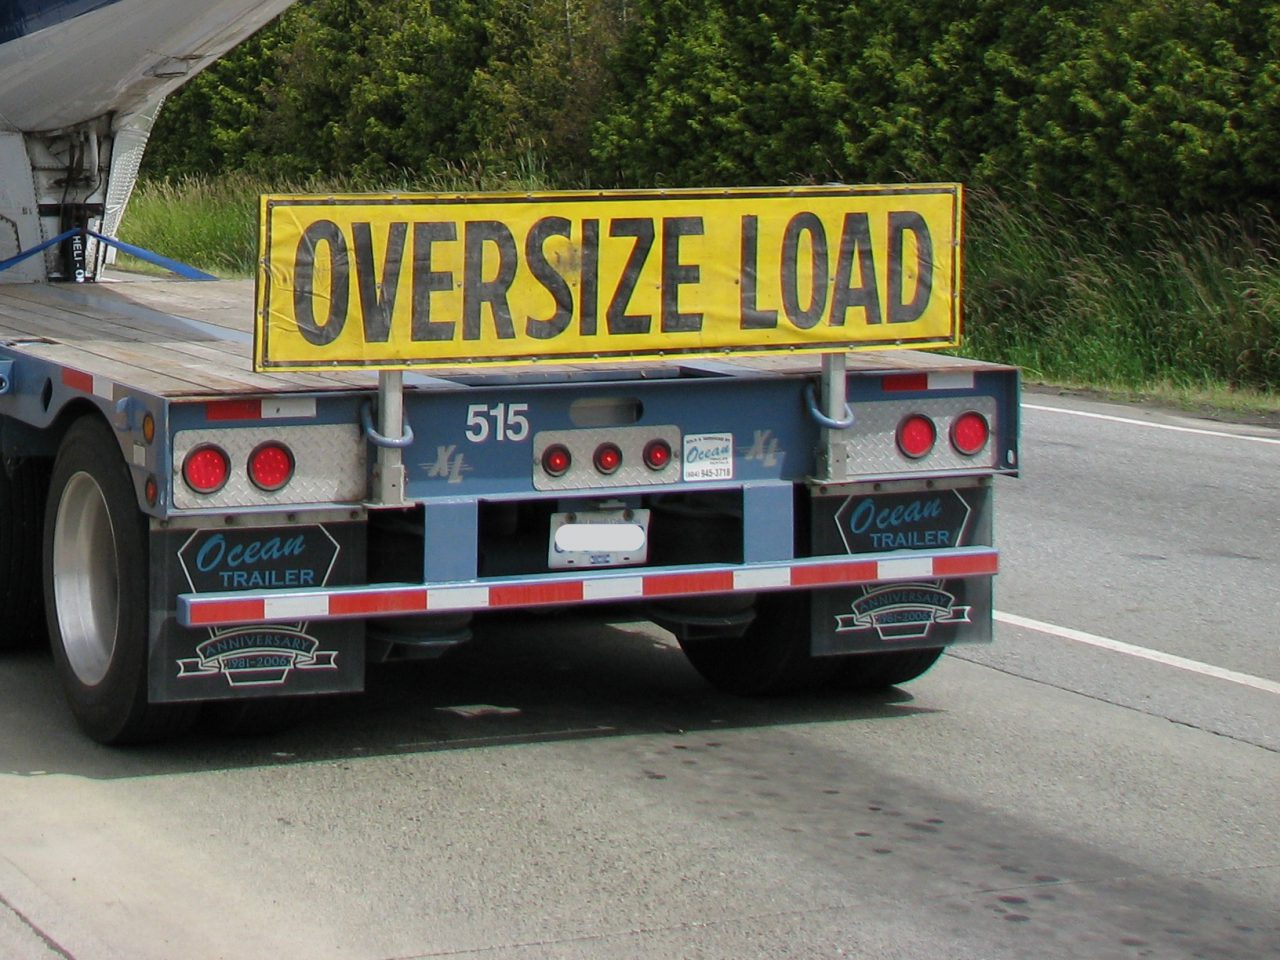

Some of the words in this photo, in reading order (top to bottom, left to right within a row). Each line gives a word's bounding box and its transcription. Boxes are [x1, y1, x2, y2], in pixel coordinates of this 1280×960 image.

[293, 215, 705, 347] OVERSIZE
[740, 210, 933, 331] LOAD
[465, 402, 529, 442] 515
[686, 445, 730, 464] Ocean
[850, 497, 942, 534] Ocean
[870, 530, 950, 547] TRAILER
[196, 533, 306, 572] Ocean
[219, 569, 315, 587] TRAILER
[859, 592, 947, 615] ANNIVERSARY
[206, 635, 310, 657] ANNIVERSARY
[228, 656, 287, 668] 1981-2006
